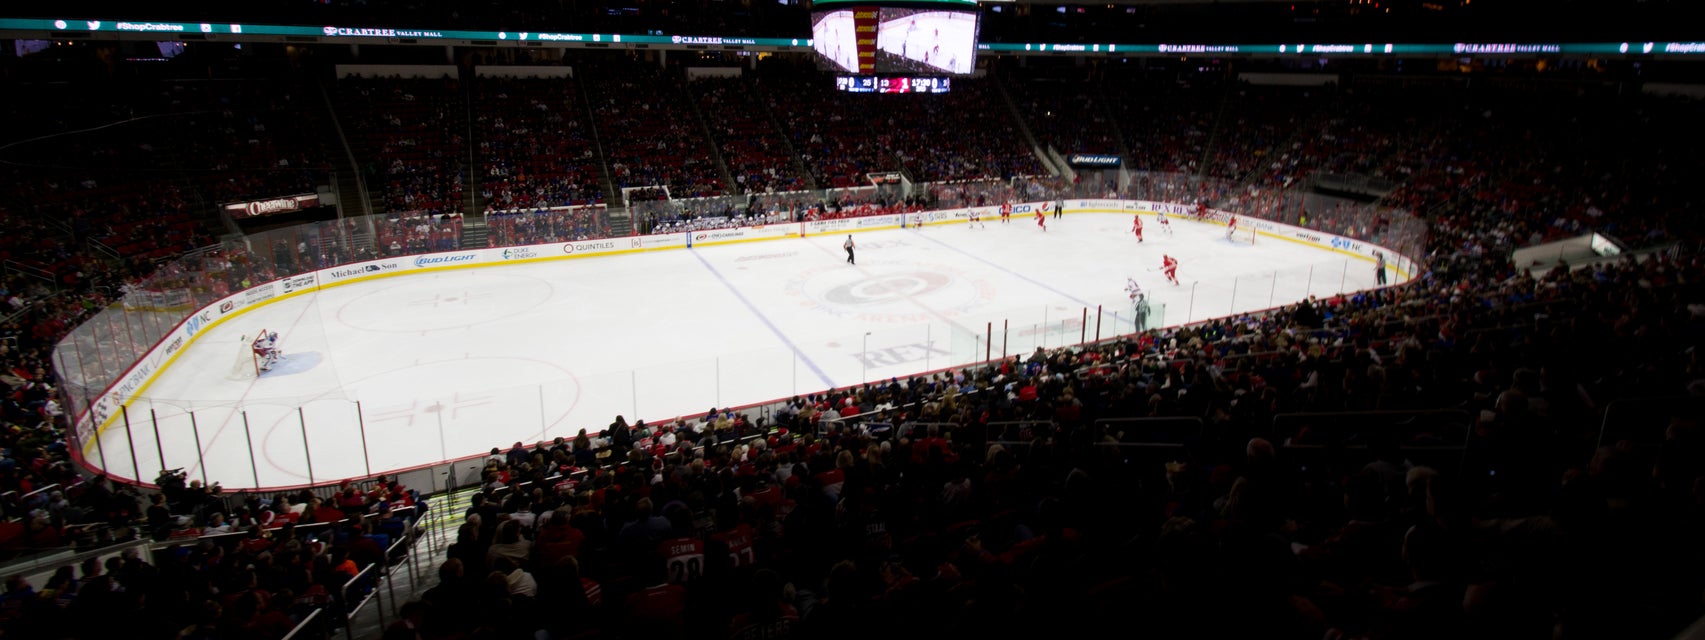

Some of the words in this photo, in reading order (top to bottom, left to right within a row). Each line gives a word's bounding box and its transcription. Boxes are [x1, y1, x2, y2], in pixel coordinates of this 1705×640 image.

[116, 22, 184, 31] #ShopCrabtree
[338, 28, 396, 37] CRABTREE
[538, 33, 582, 41] #ShopCrabtree
[902, 78, 908, 89] 1
[1073, 154, 1093, 164] BUD
[1093, 156, 1119, 164] LIGHT
[249, 198, 295, 216] Cheerwine
[998, 204, 1031, 214] GICO
[1296, 231, 1321, 242] verizon
[575, 242, 614, 252] QUINTILES
[1351, 243, 1364, 252] NC
[416, 255, 443, 265] BUD
[443, 253, 476, 262] LIGHT
[514, 251, 537, 259] ENERGY
[331, 265, 365, 279] Michael
[381, 261, 398, 270] Son
[199, 310, 212, 324] NC
[847, 339, 952, 370] REX
[671, 543, 696, 555] SEMIN
